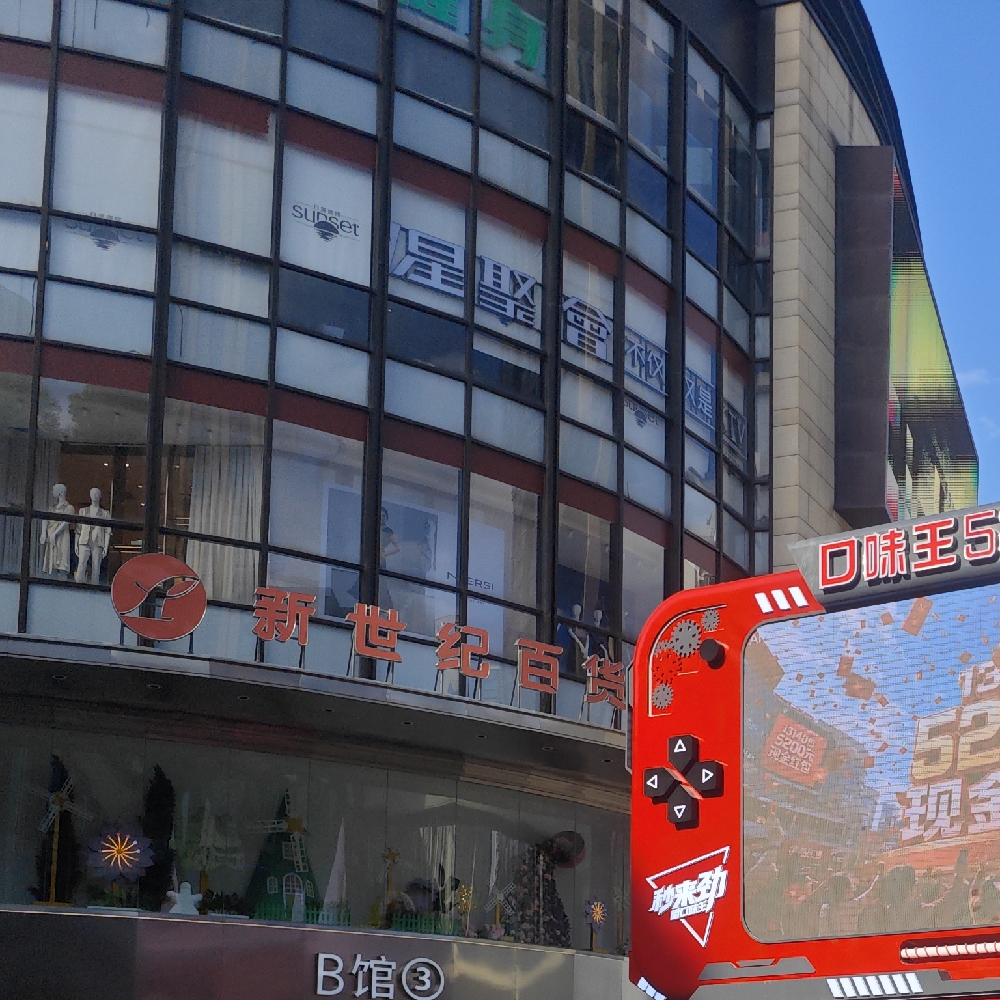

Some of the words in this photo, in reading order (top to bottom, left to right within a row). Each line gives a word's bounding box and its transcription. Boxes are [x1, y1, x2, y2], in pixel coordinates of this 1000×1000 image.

[292, 204, 359, 237] sunset
[252, 586, 626, 709] 新世纪百货
[775, 734, 815, 763] 5200元
